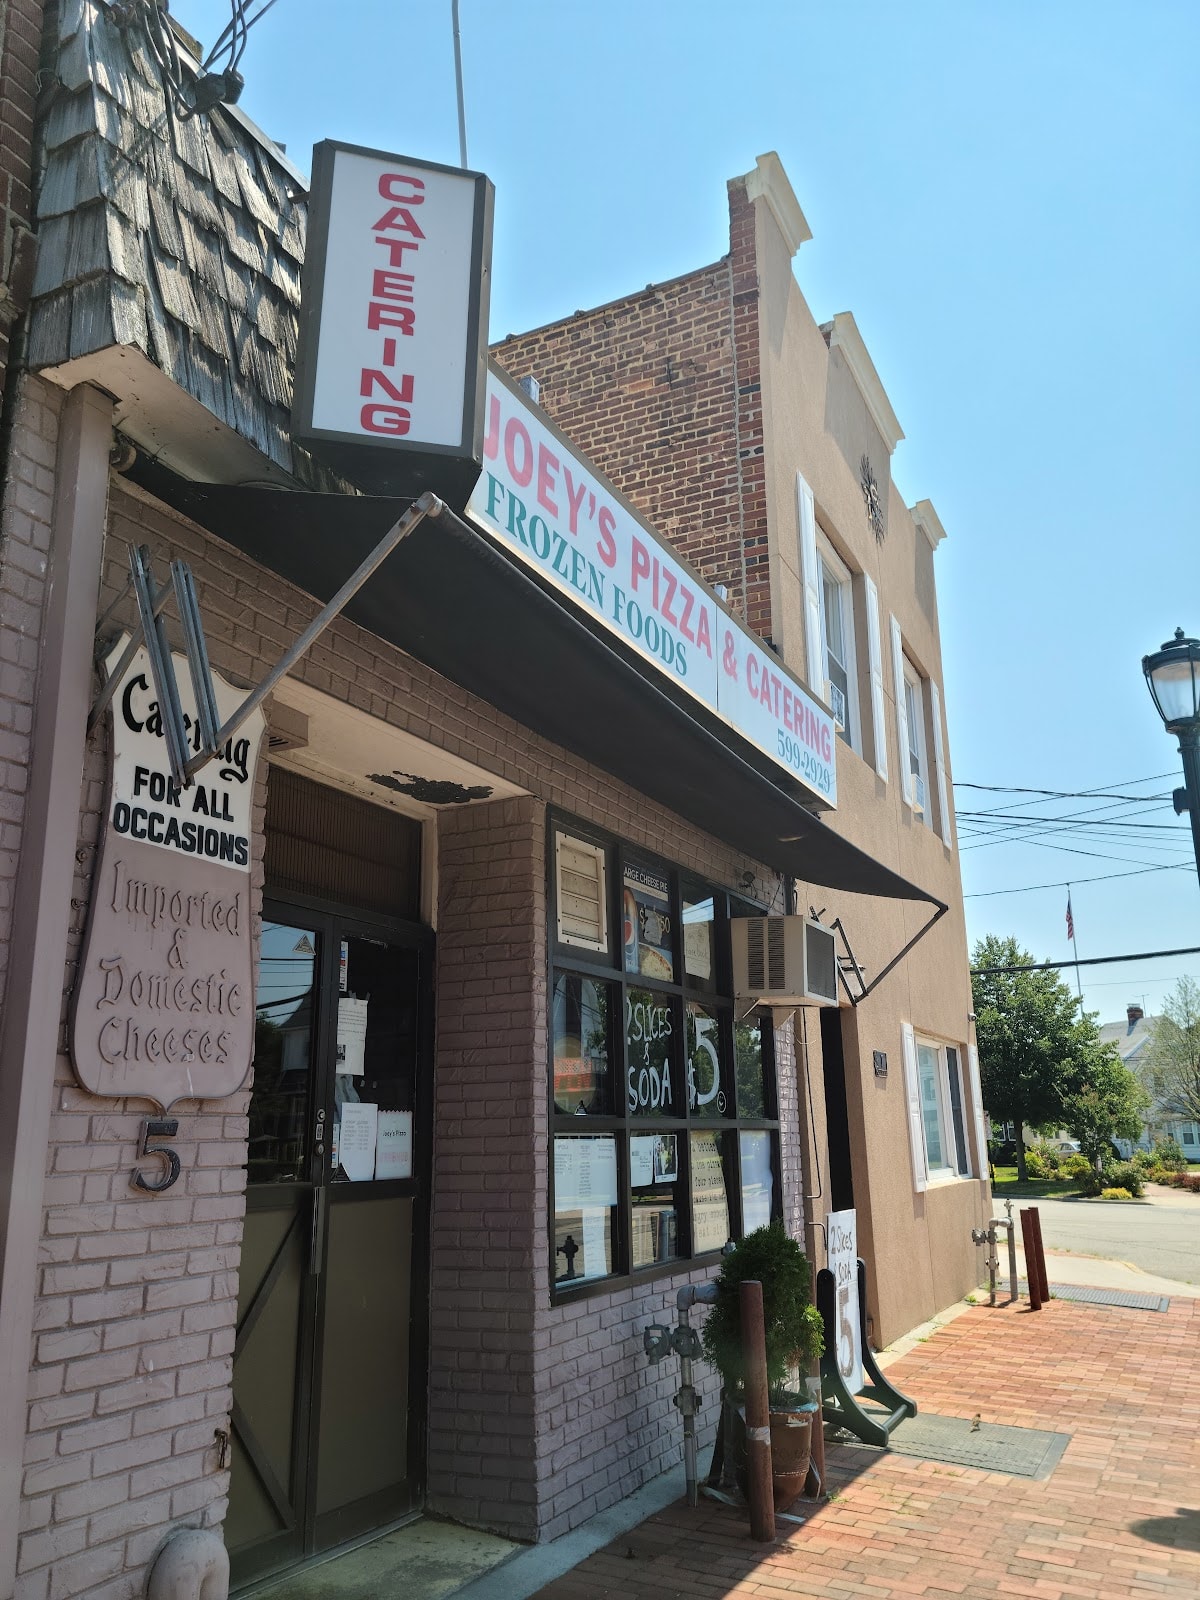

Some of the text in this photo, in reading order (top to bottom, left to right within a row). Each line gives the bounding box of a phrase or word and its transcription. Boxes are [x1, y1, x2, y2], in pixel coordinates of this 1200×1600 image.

[360, 173, 426, 436] CATERING
[483, 393, 832, 764] JOEY'S PIZZA & CATERING
[485, 470, 687, 677] FROZEN FOODS
[777, 727, 831, 793] 599-2929
[133, 765, 235, 823] FOR ALL
[113, 802, 249, 866] OCCASIONS
[111, 860, 241, 937] Imported
[640, 872, 660, 890] CHEESE
[660, 881, 668, 893] PIE
[167, 928, 188, 969] &
[97, 956, 241, 1016] Domestic
[98, 1016, 231, 1065] Cheeses
[632, 1002, 673, 1042] SLICES
[628, 1058, 673, 1112] SODA
[130, 1117, 181, 1193] 5
